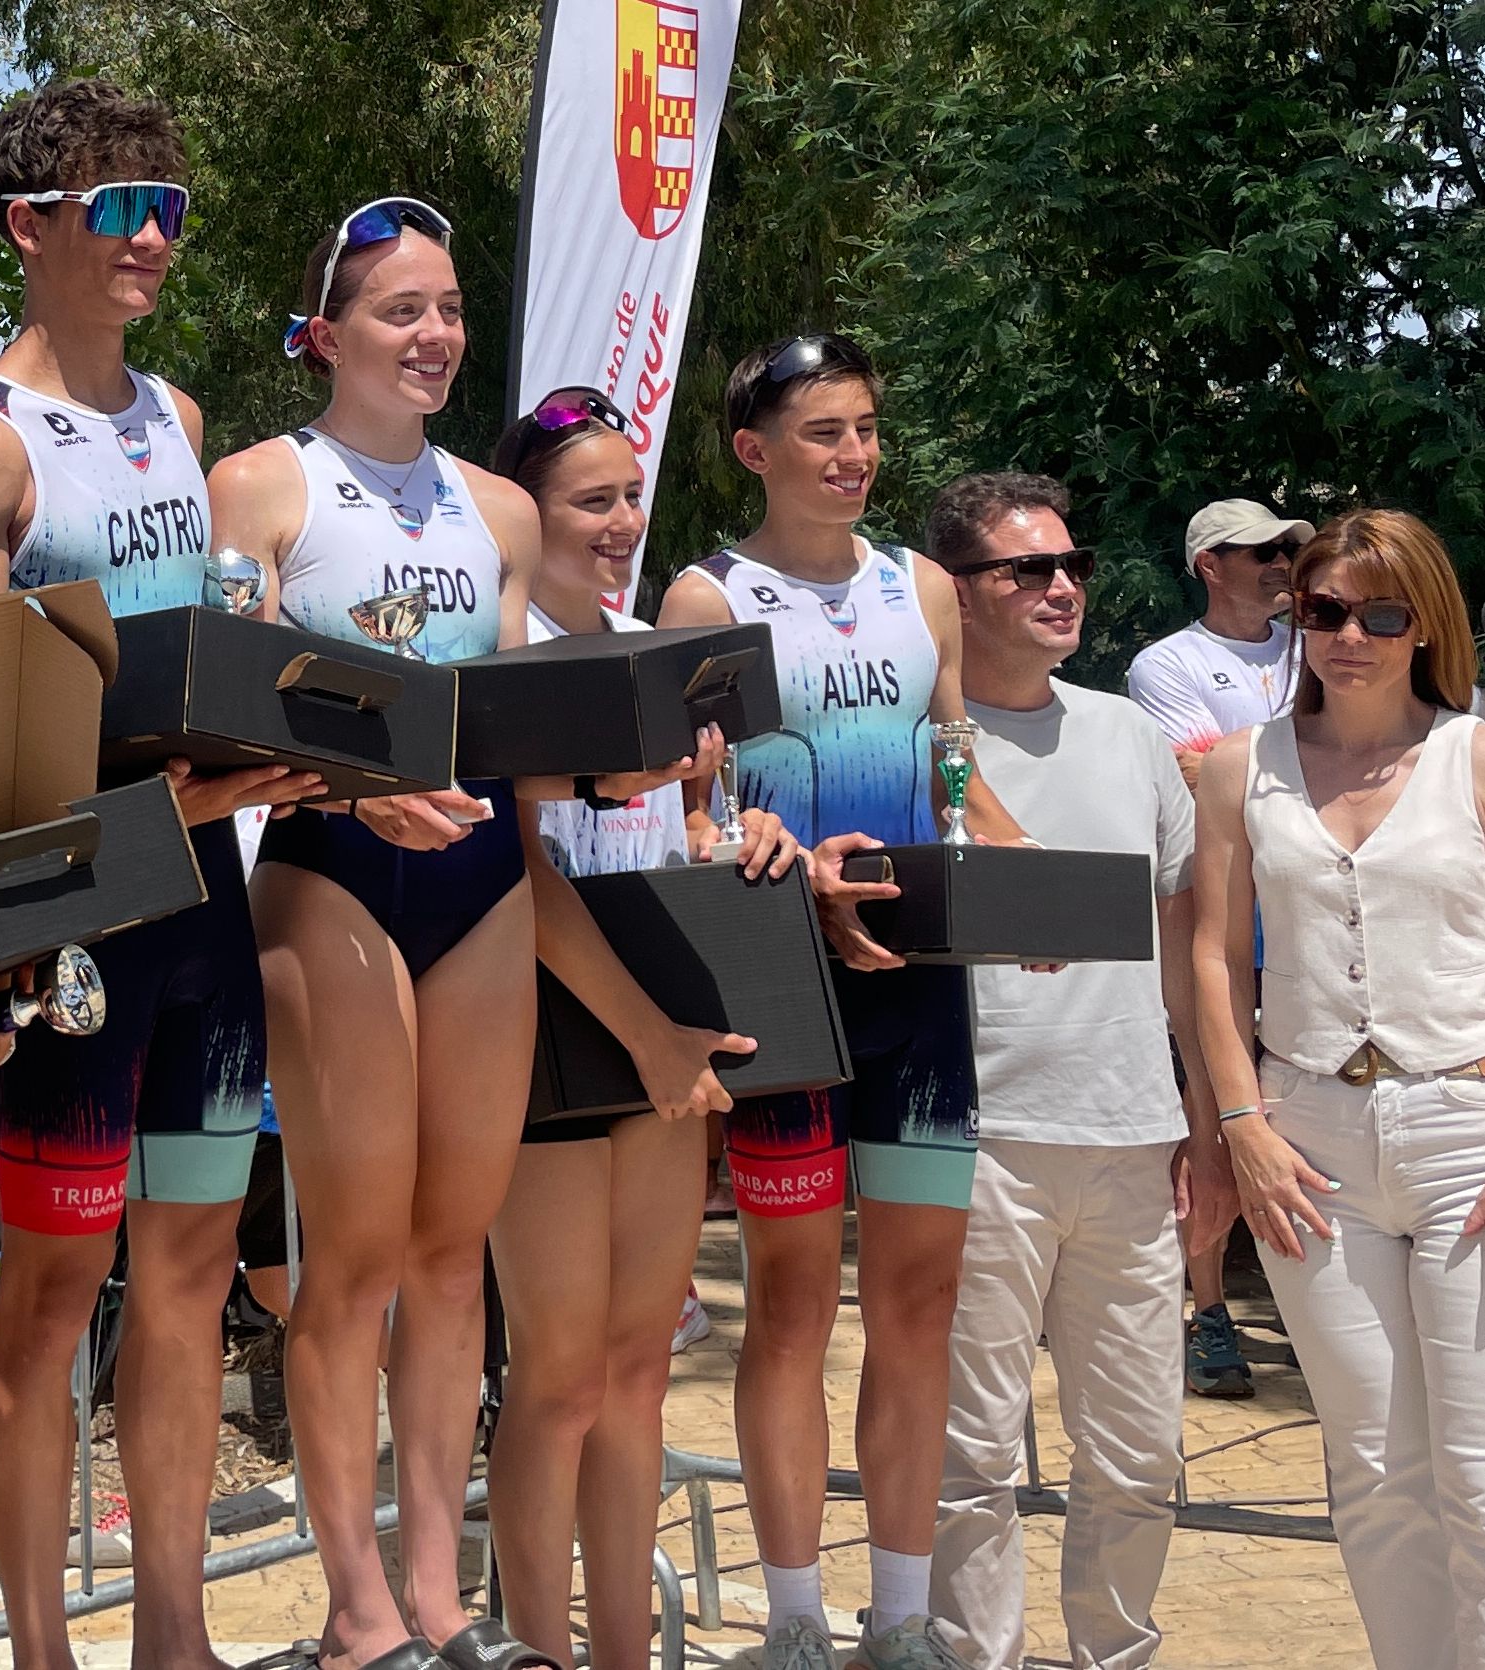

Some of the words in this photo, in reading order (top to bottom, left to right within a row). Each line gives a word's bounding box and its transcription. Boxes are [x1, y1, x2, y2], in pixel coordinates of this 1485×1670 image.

[615, 290, 638, 339] de
[627, 291, 672, 491] UQUE
[108, 495, 205, 568] CASTRO
[822, 649, 900, 711] ALÍAS
[52, 1180, 125, 1205] TRIBAR
[731, 1167, 834, 1194] TRIBARROS
[745, 1191, 817, 1206] VILLAFRANCA
